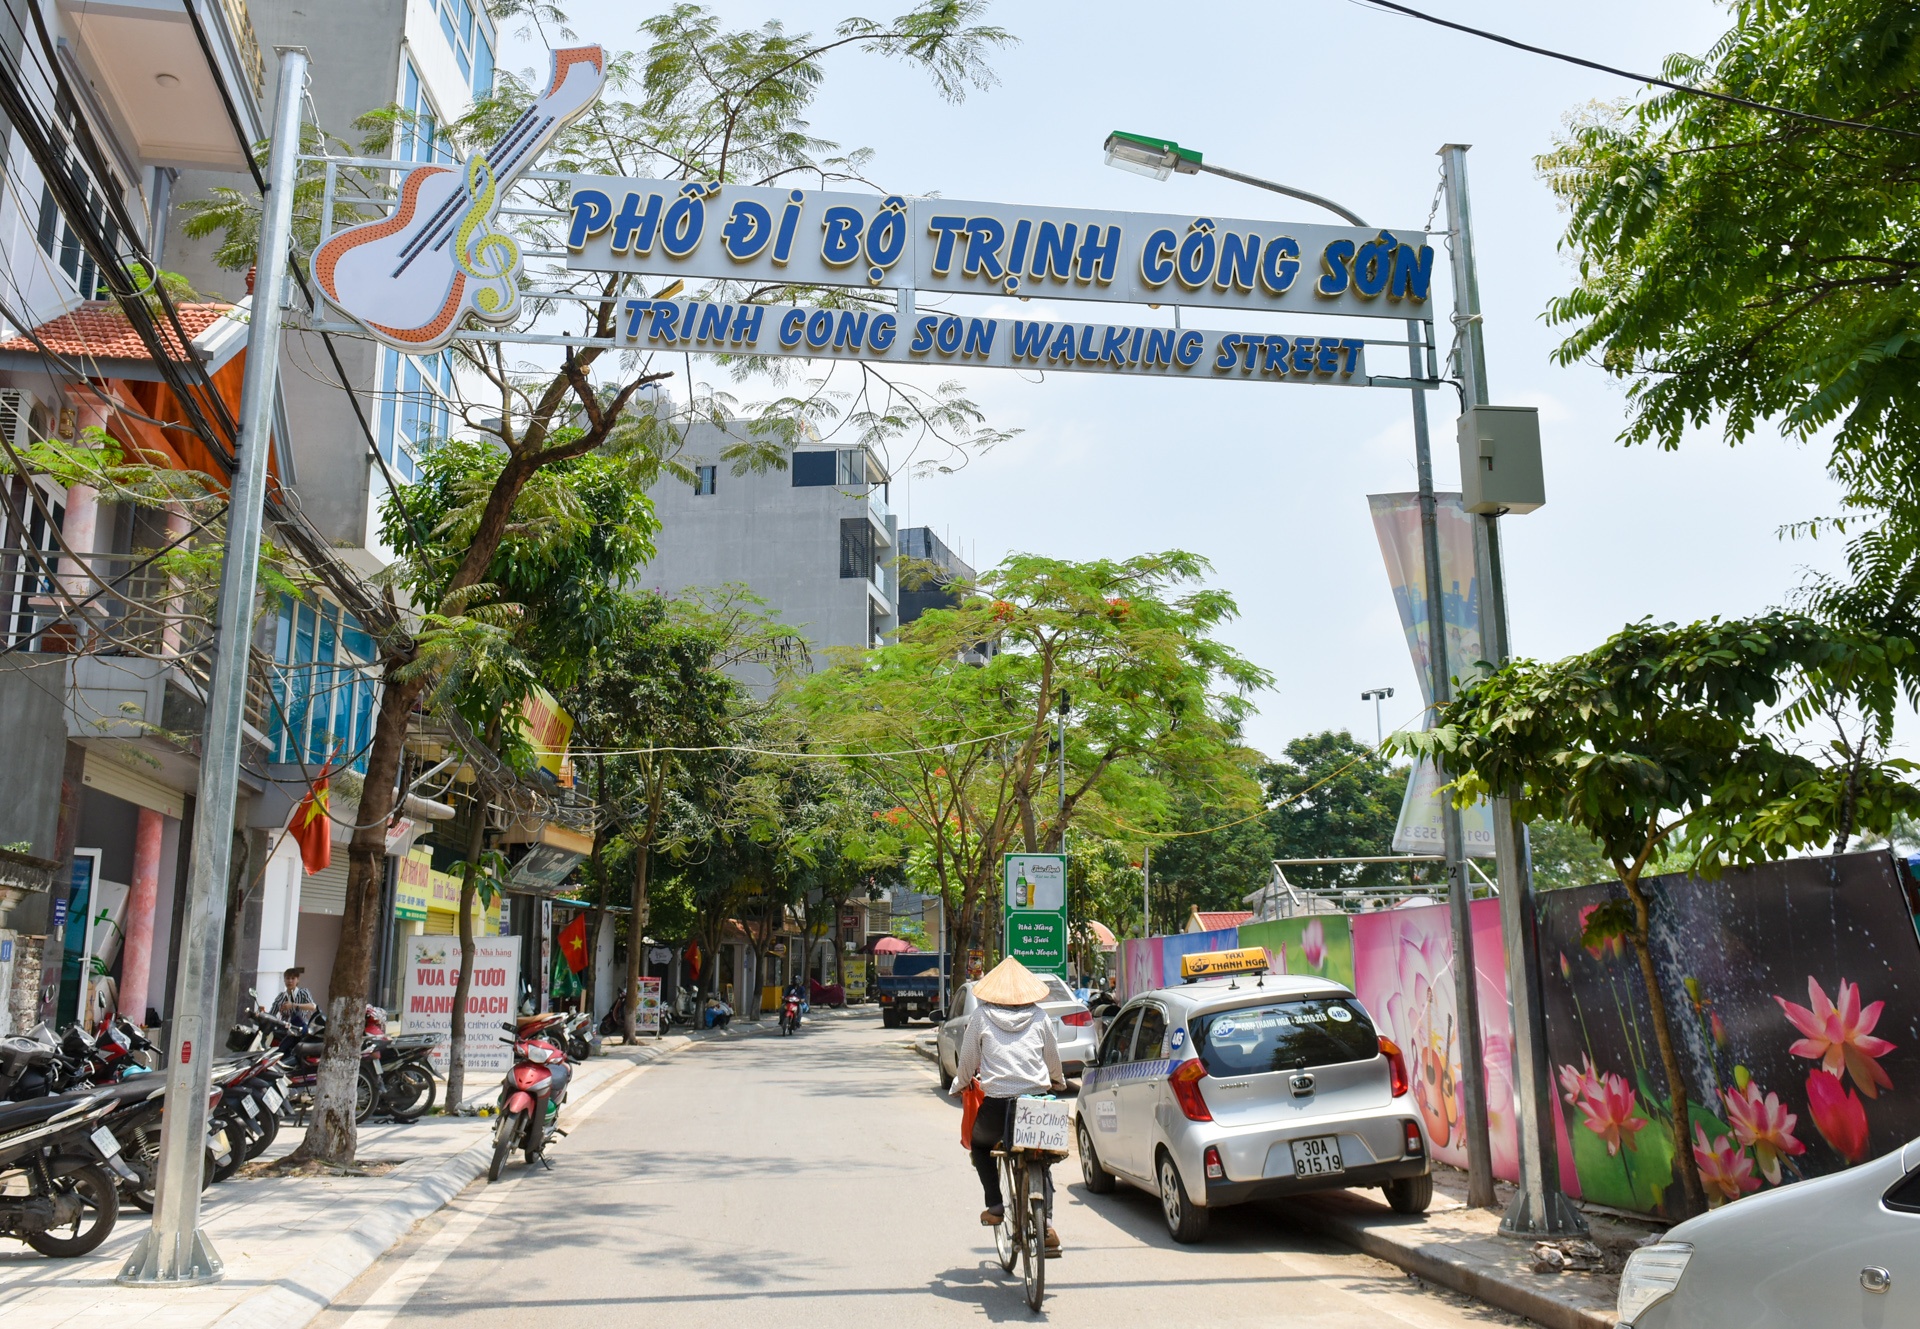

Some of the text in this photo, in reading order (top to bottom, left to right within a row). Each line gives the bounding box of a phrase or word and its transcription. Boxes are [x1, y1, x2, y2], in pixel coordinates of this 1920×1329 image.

[568, 179, 723, 260] PHỐ
[820, 196, 910, 286] BỘ
[927, 214, 1122, 294] TRỊNH
[1141, 217, 1302, 295] CÔNG
[1317, 229, 1435, 302] SƠN
[624, 300, 1364, 379] TRINH CONG SON WALKING STREET
[1223, 952, 1244, 960] TAXI
[1211, 960, 1243, 970] THANH
[1245, 958, 1267, 967] NGA
[417, 967, 506, 987] VUA G TƯƠI
[1332, 1010, 1348, 1018] 485
[1255, 1018, 1277, 1029] THANH
[1277, 1017, 1291, 1026] NGA
[1296, 1079, 1311, 1088] KIA
[1303, 1139, 1328, 1156] 30A
[1297, 1155, 1341, 1174] 815.19
